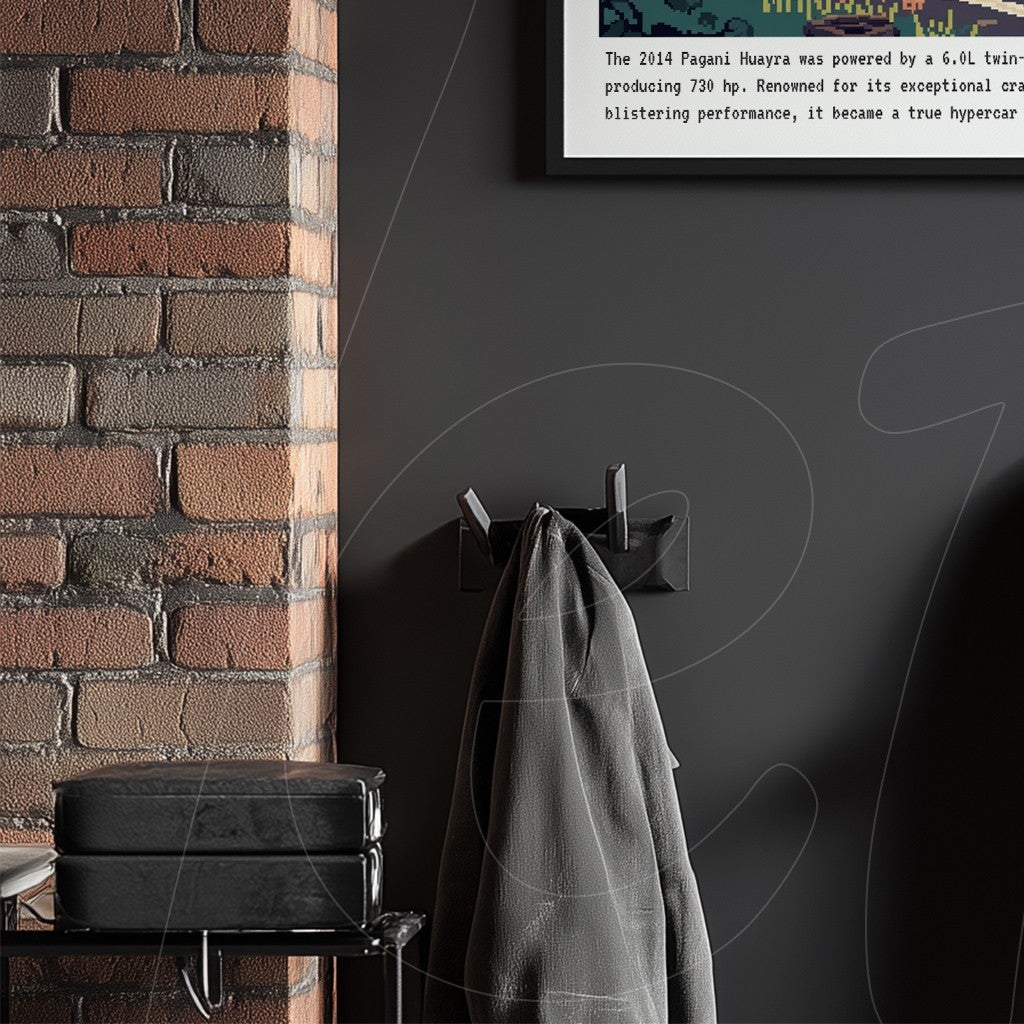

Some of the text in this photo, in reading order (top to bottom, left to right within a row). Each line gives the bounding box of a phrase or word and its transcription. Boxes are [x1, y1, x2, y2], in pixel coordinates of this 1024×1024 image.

[605, 51, 631, 66] The
[639, 51, 673, 66] 2014
[681, 51, 731, 69] Pagani
[740, 51, 791, 69] Huayra
[799, 55, 824, 66] was
[832, 50, 892, 69] powered
[899, 50, 917, 69] by
[924, 54, 934, 66] a
[942, 50, 976, 66] 6.0L
[605, 78, 681, 97] producing
[690, 78, 714, 93] 730
[723, 78, 747, 97] hp.
[756, 78, 824, 93] Renowned
[833, 78, 858, 93] for
[867, 78, 891, 93] its
[900, 78, 992, 96] exceptional
[605, 106, 690, 124] blistering
[698, 106, 798, 124] performance,
[808, 105, 824, 120] it
[832, 105, 883, 120] became
[891, 109, 900, 120] a
[908, 105, 942, 120] true
[950, 105, 1018, 123] hypercar
